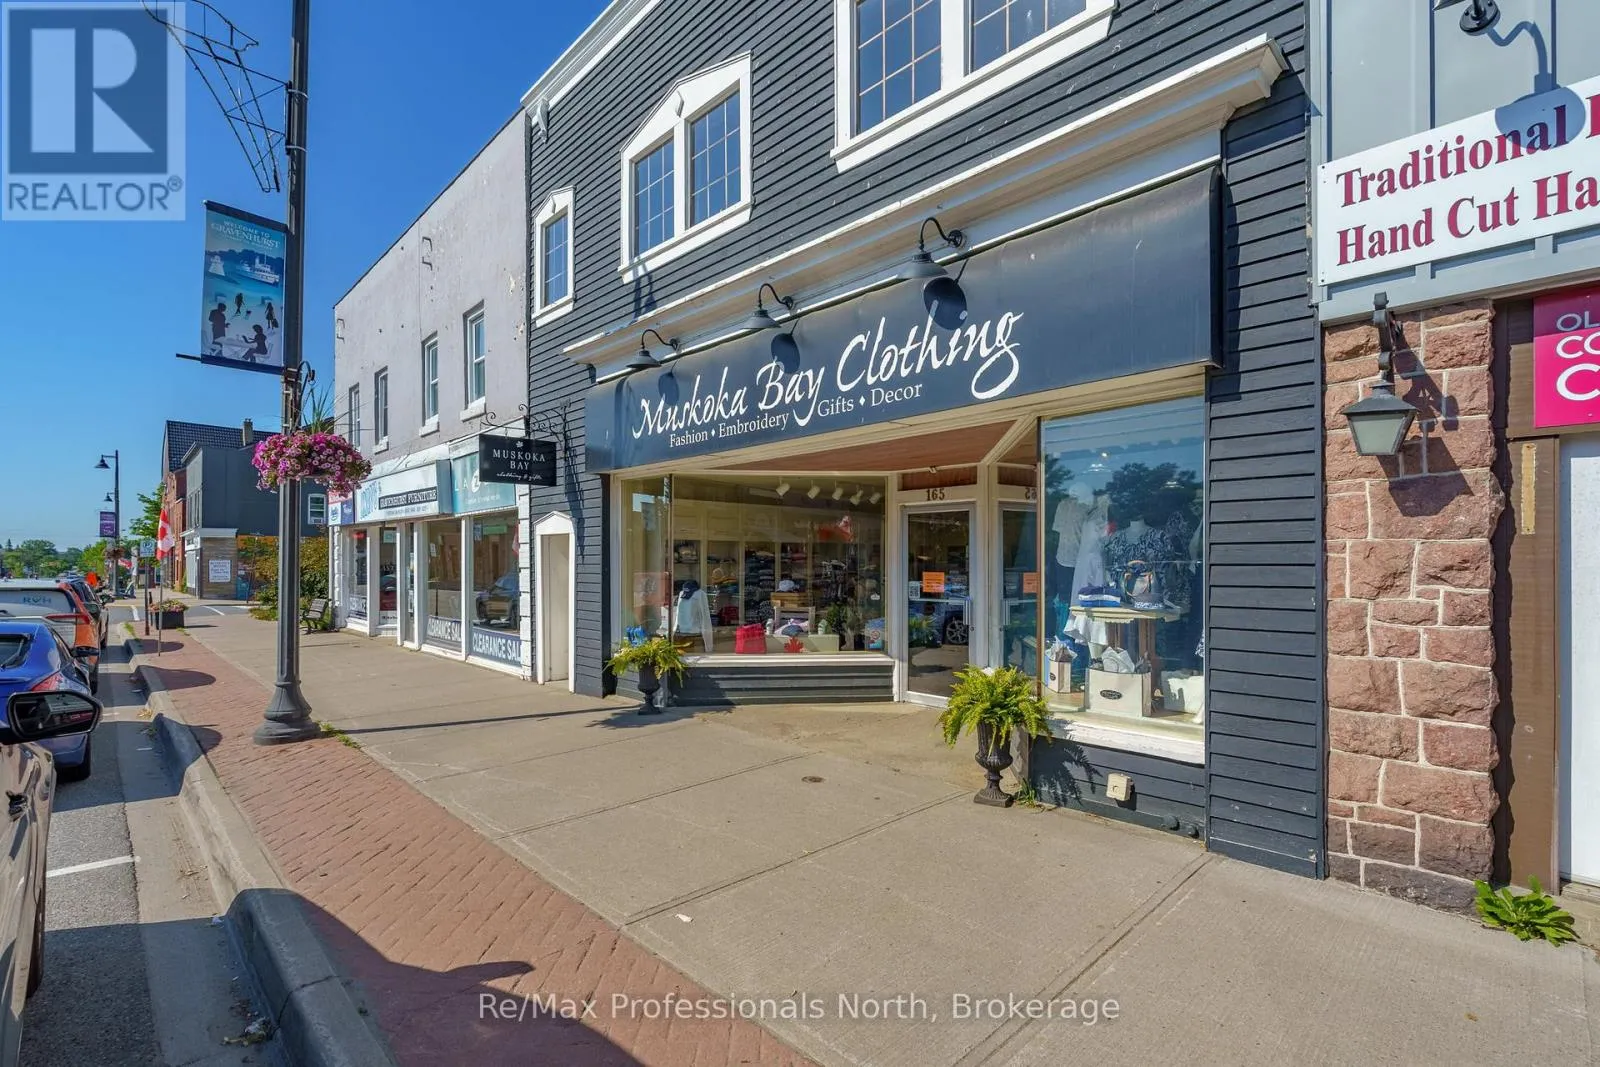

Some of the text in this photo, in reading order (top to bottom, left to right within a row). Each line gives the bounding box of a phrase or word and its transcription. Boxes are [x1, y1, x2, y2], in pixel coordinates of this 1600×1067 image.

[1336, 104, 1569, 208] Traditional
[211, 223, 281, 248] GRAVENHURST
[1336, 207, 1434, 266] Hand
[1447, 187, 1520, 239] Cut
[632, 311, 1024, 439] Muskoka Bay Clothing
[669, 384, 922, 448] Fashion Embroidery Gifts Decor
[493, 448, 545, 462] MUSKOKA
[510, 461, 530, 470] BAY
[925, 488, 945, 500] 165
[451, 621, 462, 640] SAL
[472, 632, 522, 662] CLEARANCE SAL
